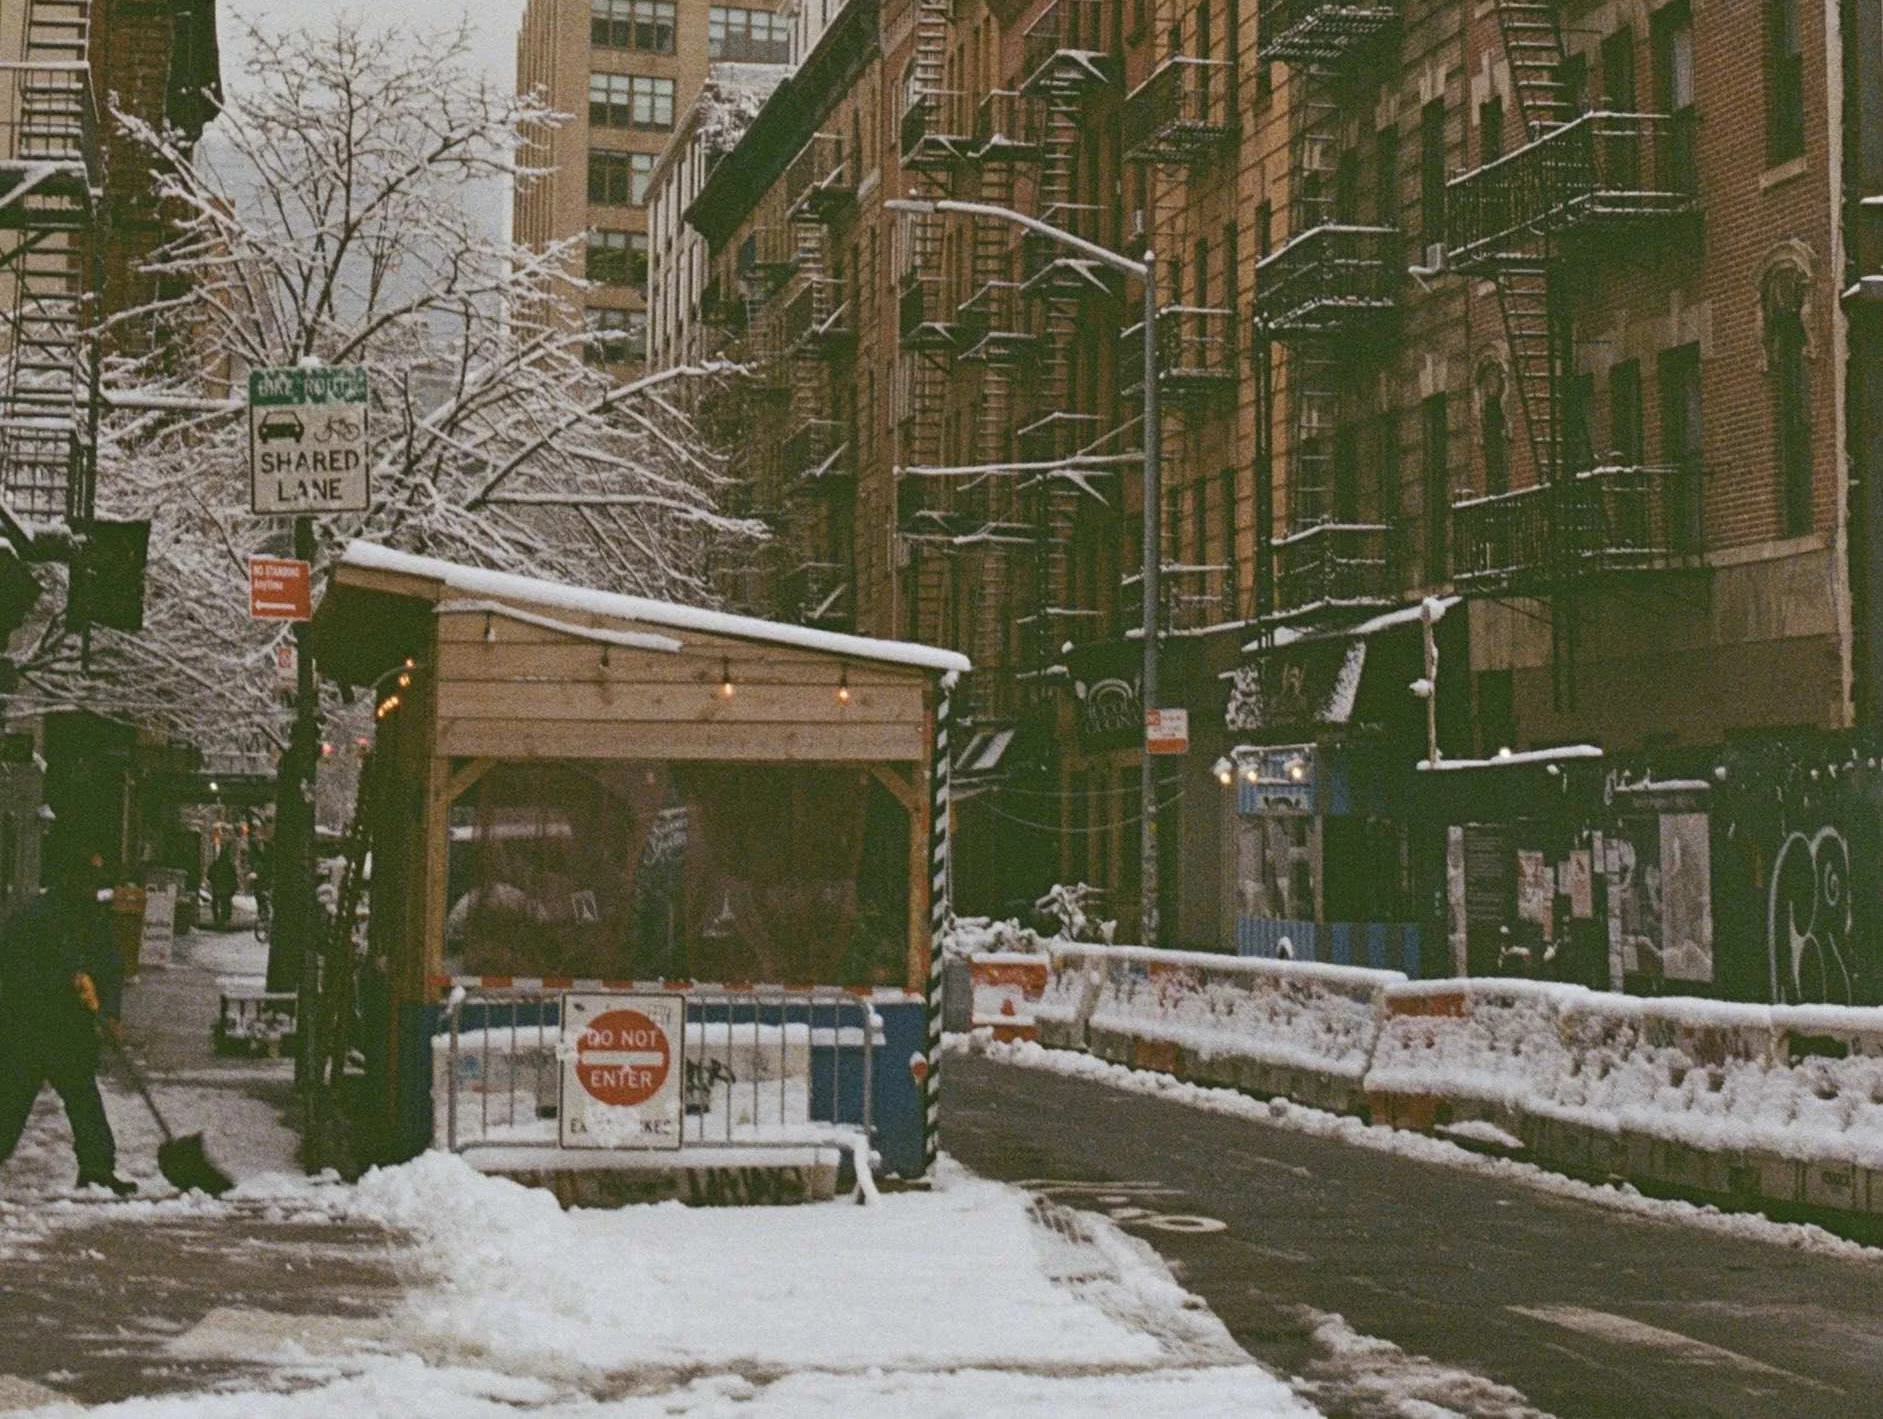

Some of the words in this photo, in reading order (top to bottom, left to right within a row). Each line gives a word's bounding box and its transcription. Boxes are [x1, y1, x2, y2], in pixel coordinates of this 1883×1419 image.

[261, 449, 360, 474] SHARED
[277, 478, 343, 501] LANE
[586, 1030, 613, 1048] DO
[620, 1031, 657, 1048] NOT
[590, 1070, 653, 1088] ENTER
